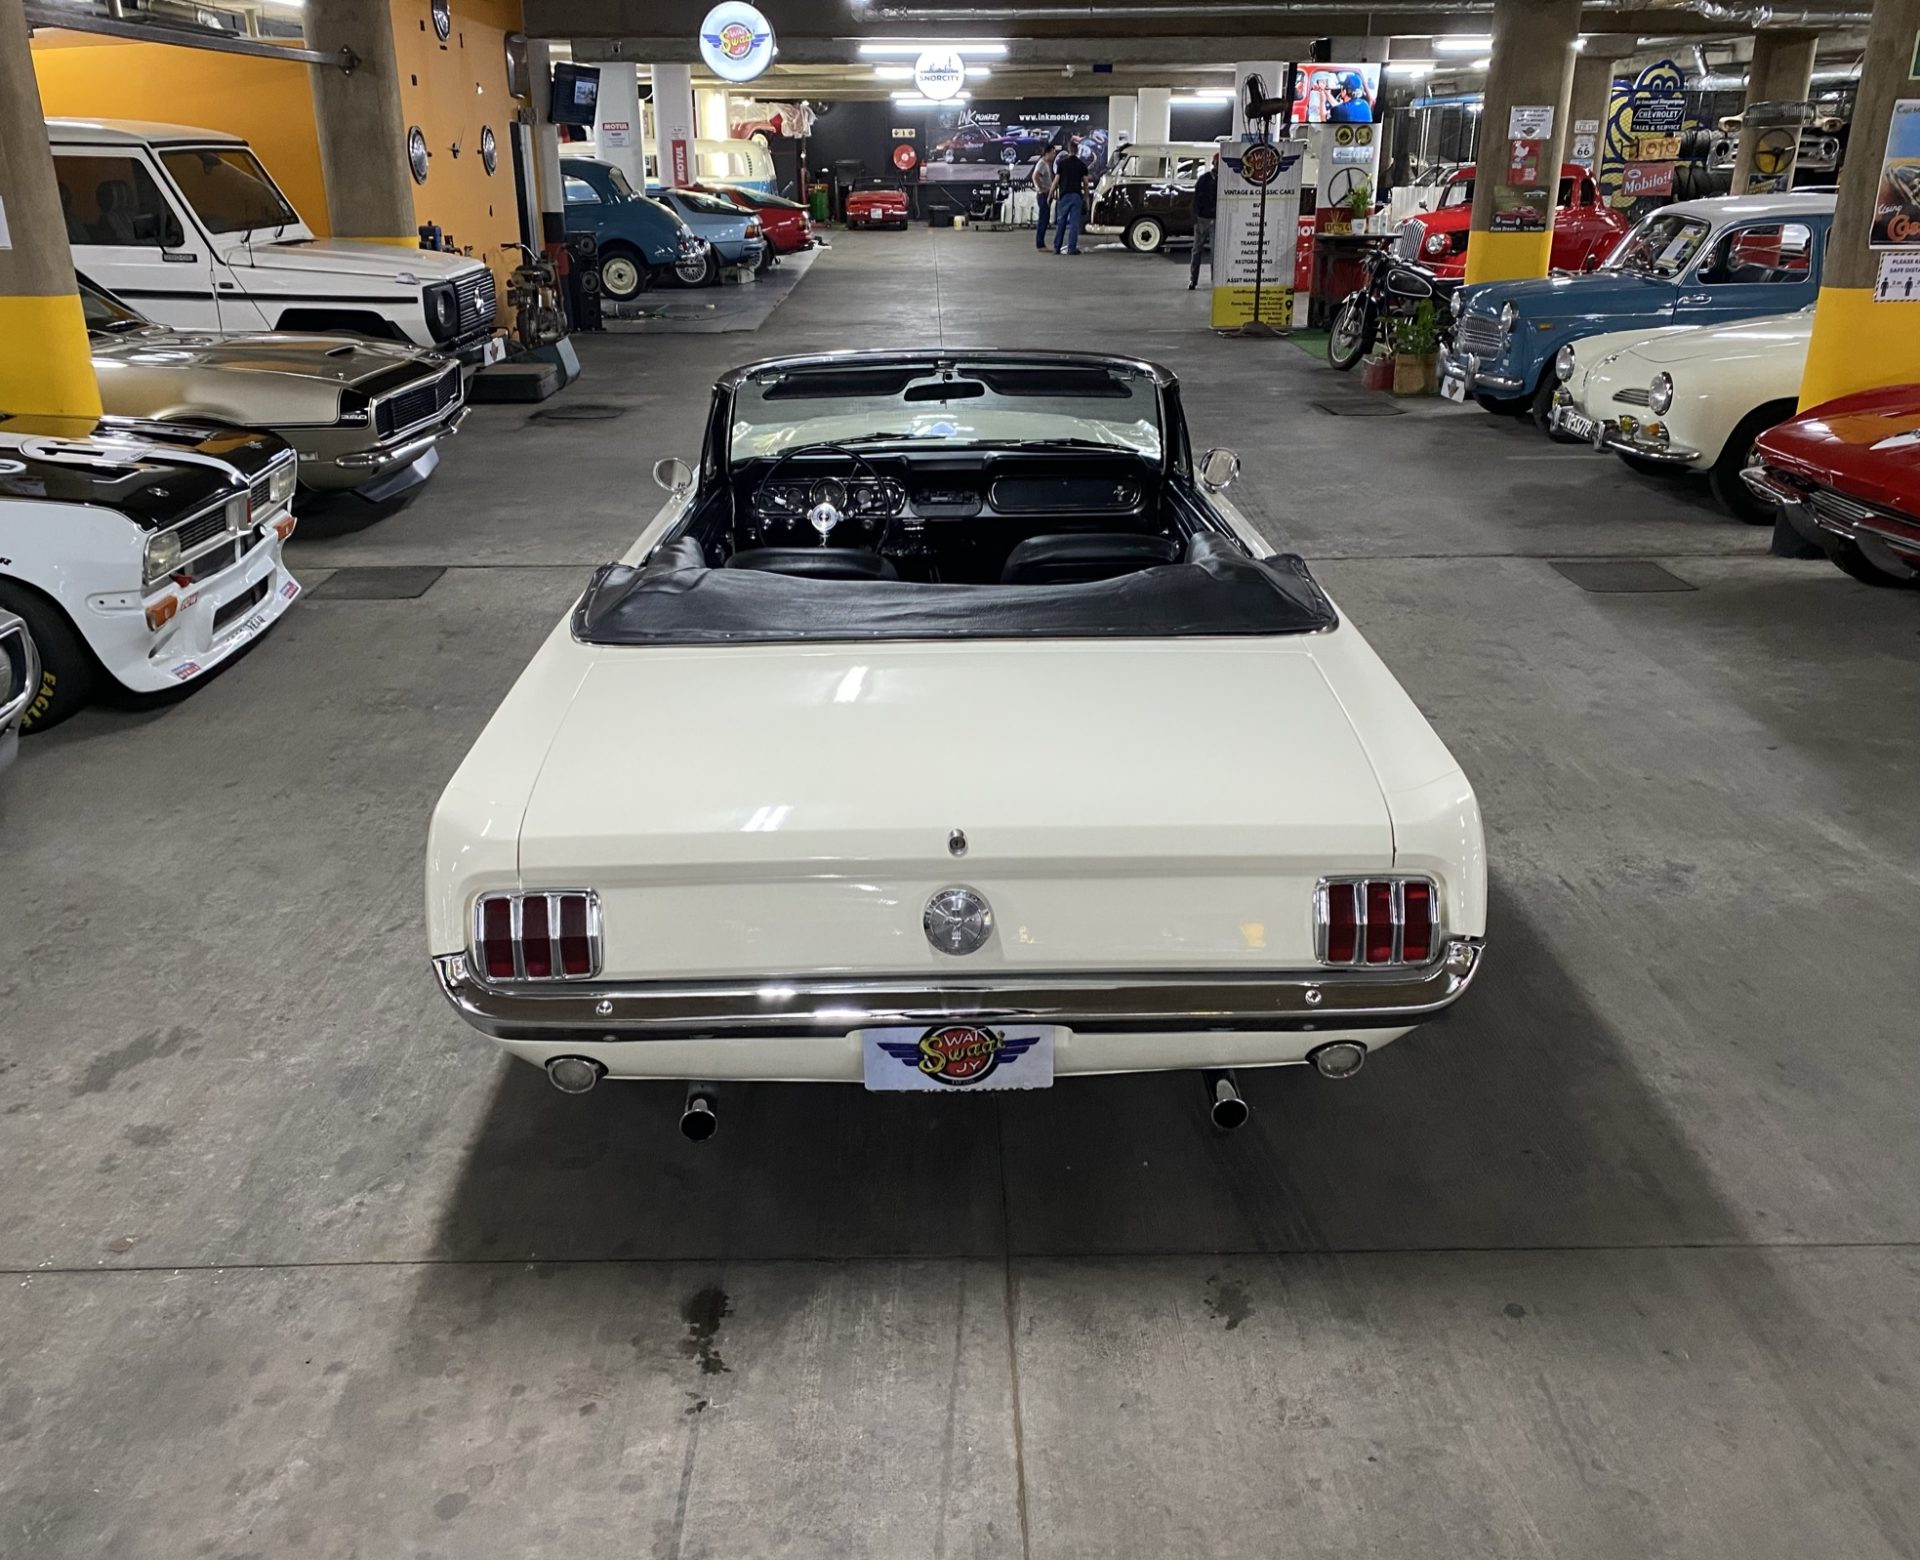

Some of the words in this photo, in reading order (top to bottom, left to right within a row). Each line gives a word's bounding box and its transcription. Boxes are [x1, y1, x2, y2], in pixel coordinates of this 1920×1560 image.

[919, 74, 960, 82] SNORCITY
[975, 113, 1000, 121] MONKEY
[1019, 112, 1090, 122] www.inkmonkey.co
[1638, 110, 1679, 119] CHEVROLET
[1577, 146, 1590, 156] 66
[676, 146, 686, 181] MOTUL
[1623, 169, 1672, 195] Mobiloil
[22, 670, 57, 728] EAGLE
[944, 1027, 988, 1047] WAT
[956, 1060, 981, 1073] JY
